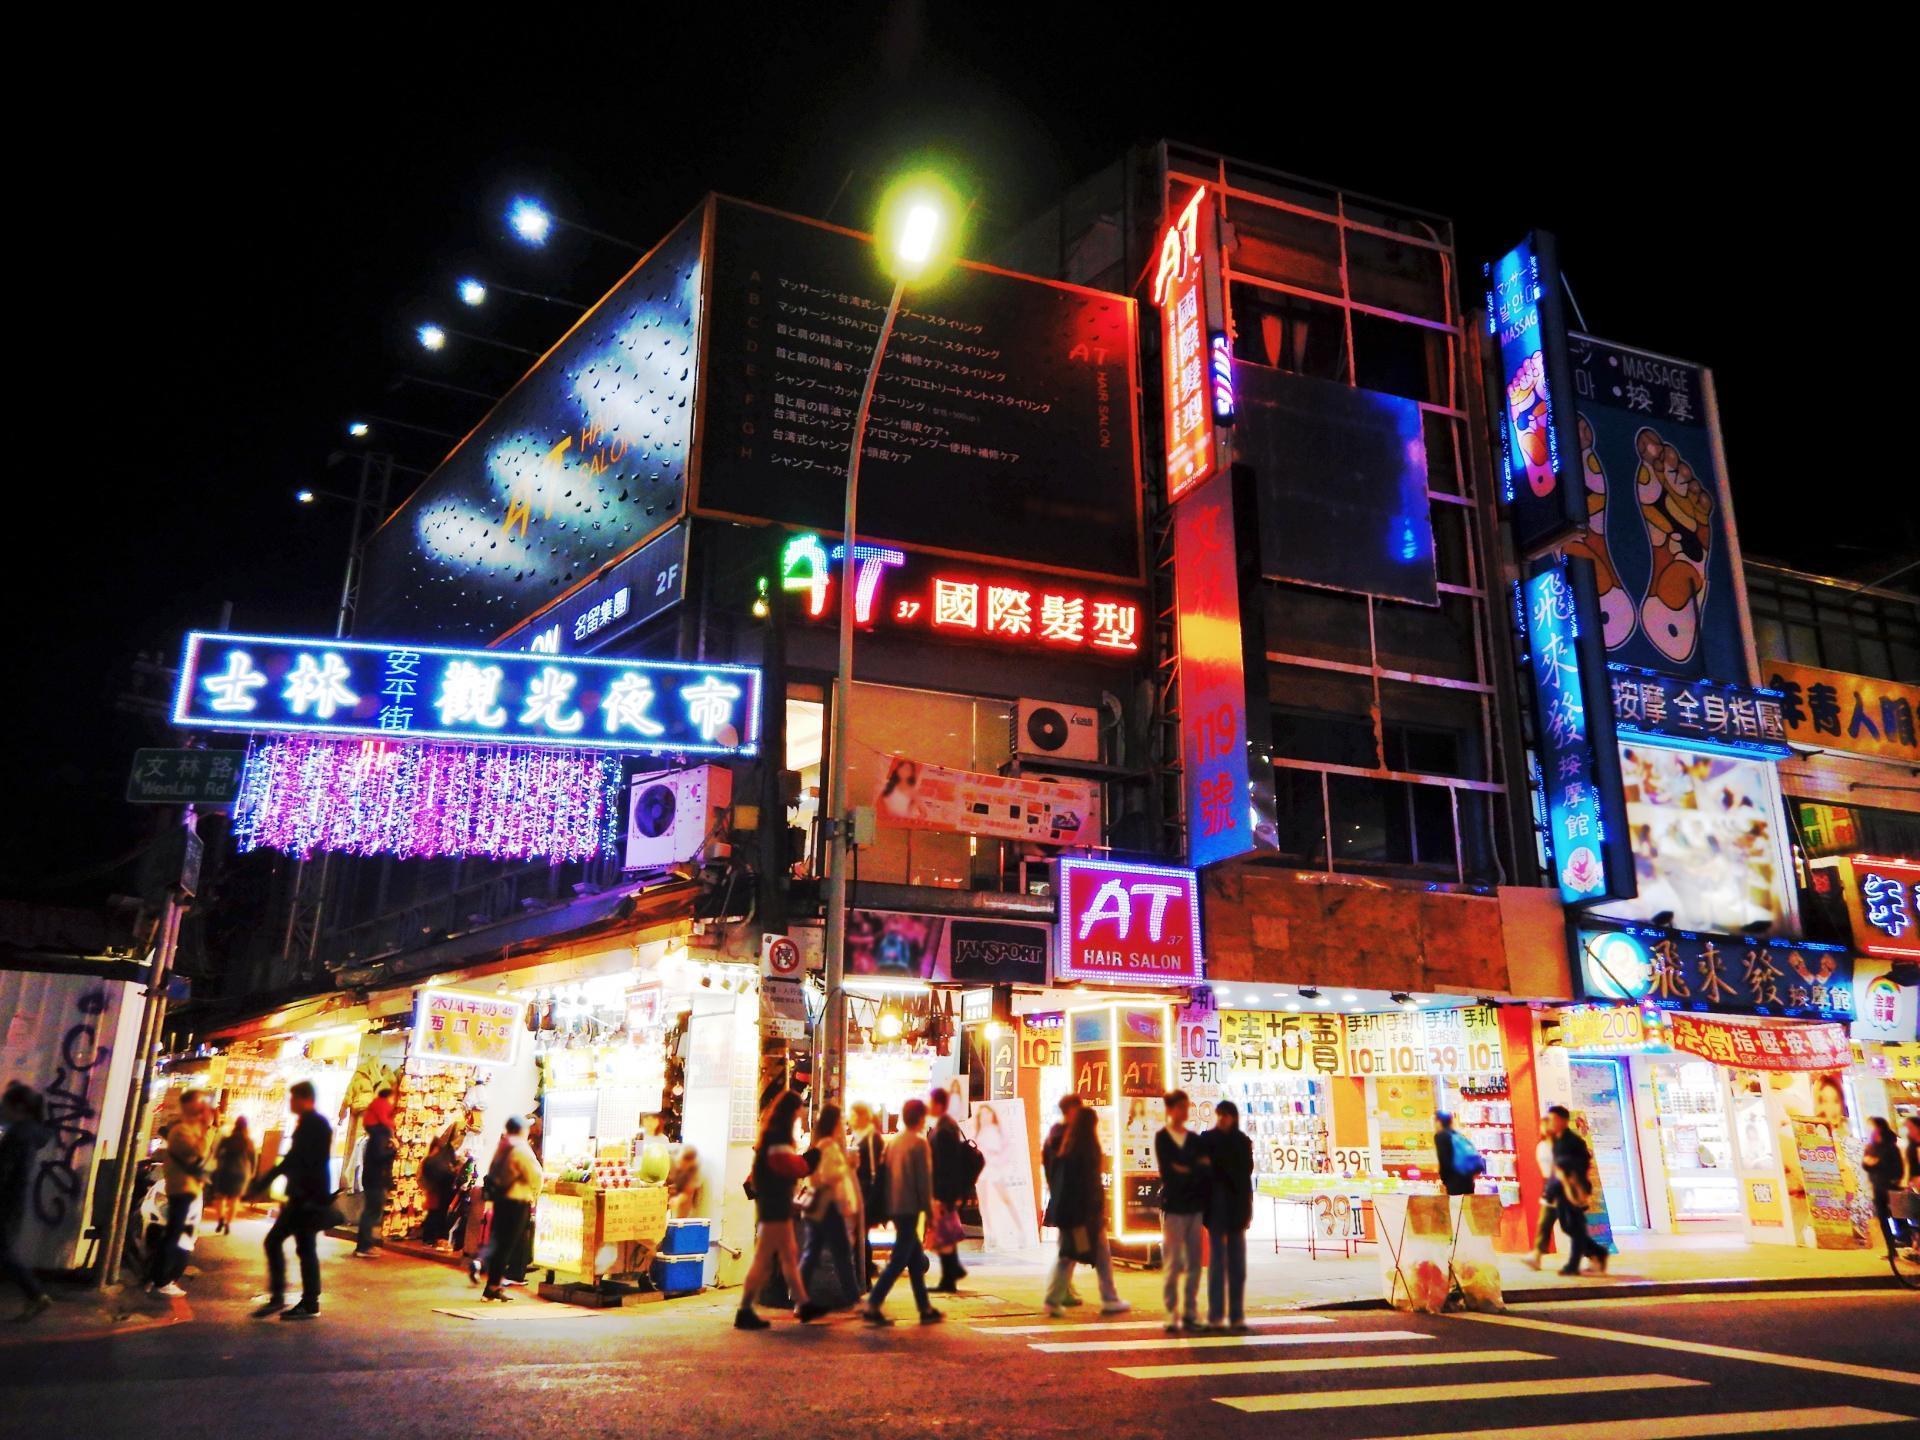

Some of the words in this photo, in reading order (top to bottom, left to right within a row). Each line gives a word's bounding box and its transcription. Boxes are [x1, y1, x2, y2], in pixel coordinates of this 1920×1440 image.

[1154, 185, 1206, 302] AT
[1622, 355, 1689, 392] MASSAGE
[1626, 380, 1694, 421] 按摩
[656, 564, 679, 597] 2F
[782, 533, 905, 623] AT
[896, 600, 921, 619] 37
[933, 577, 1139, 651] 國際髮型
[574, 586, 631, 641] 名留集團
[202, 649, 360, 722] 士林
[433, 655, 744, 743] 觀光夜市
[379, 648, 421, 733] 安平街
[1611, 677, 1668, 724] 按摩
[1534, 572, 1591, 841] 飛來發按摩館
[143, 755, 233, 779] 文林路
[142, 781, 196, 795] WenLin
[205, 780, 227, 796] Rd
[1079, 878, 1183, 942] AT
[956, 939, 1044, 965] JANSPORT
[1167, 935, 1183, 945] 37
[1083, 948, 1123, 967] HAIR
[1129, 952, 1181, 970] SALON
[1348, 1014, 1381, 1032] 手机
[1425, 1009, 1462, 1029] 手机
[1464, 1007, 1497, 1028] 手机
[1601, 1010, 1640, 1039] 200
[1023, 1038, 1063, 1066] 10元
[1180, 1025, 1221, 1059] 10元
[1468, 1042, 1503, 1070] 10元
[995, 1043, 1013, 1088] AT
[1123, 1061, 1158, 1085] AT
[1180, 1060, 1221, 1084] 手机
[1350, 1048, 1385, 1075] 10元
[1390, 1046, 1426, 1074] 10元
[1077, 1061, 1109, 1094] AT
[1273, 1146, 1310, 1171] 39元
[1335, 1150, 1371, 1172] 39元
[1137, 1185, 1152, 1196] 2F
[1314, 1194, 1365, 1237] 39元
